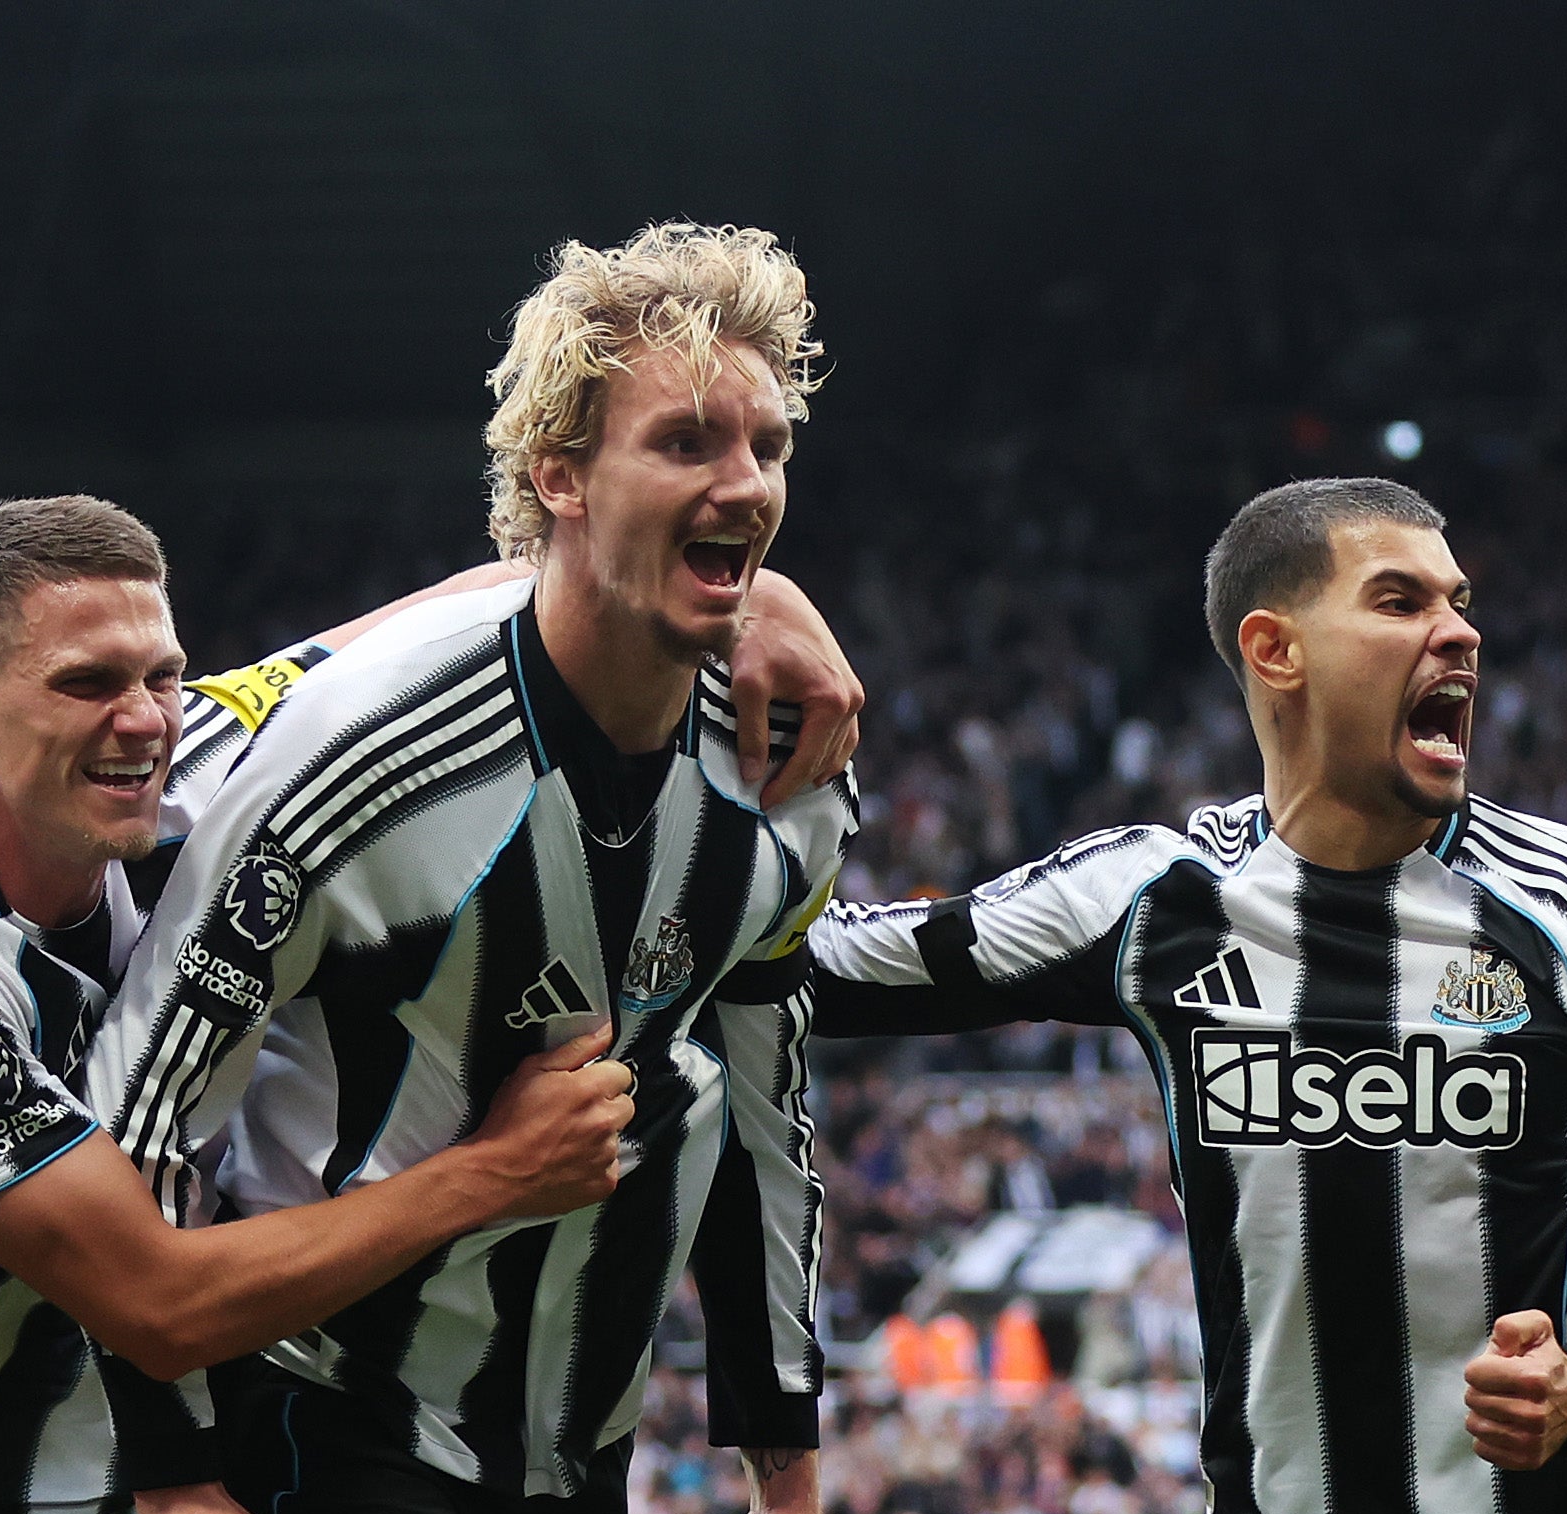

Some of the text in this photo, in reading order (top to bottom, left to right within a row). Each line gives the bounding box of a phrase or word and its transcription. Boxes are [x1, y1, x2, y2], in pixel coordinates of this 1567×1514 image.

[175, 952, 265, 1015] for racism
[180, 935, 264, 995] No room
[1290, 1047, 1510, 1136] sela
